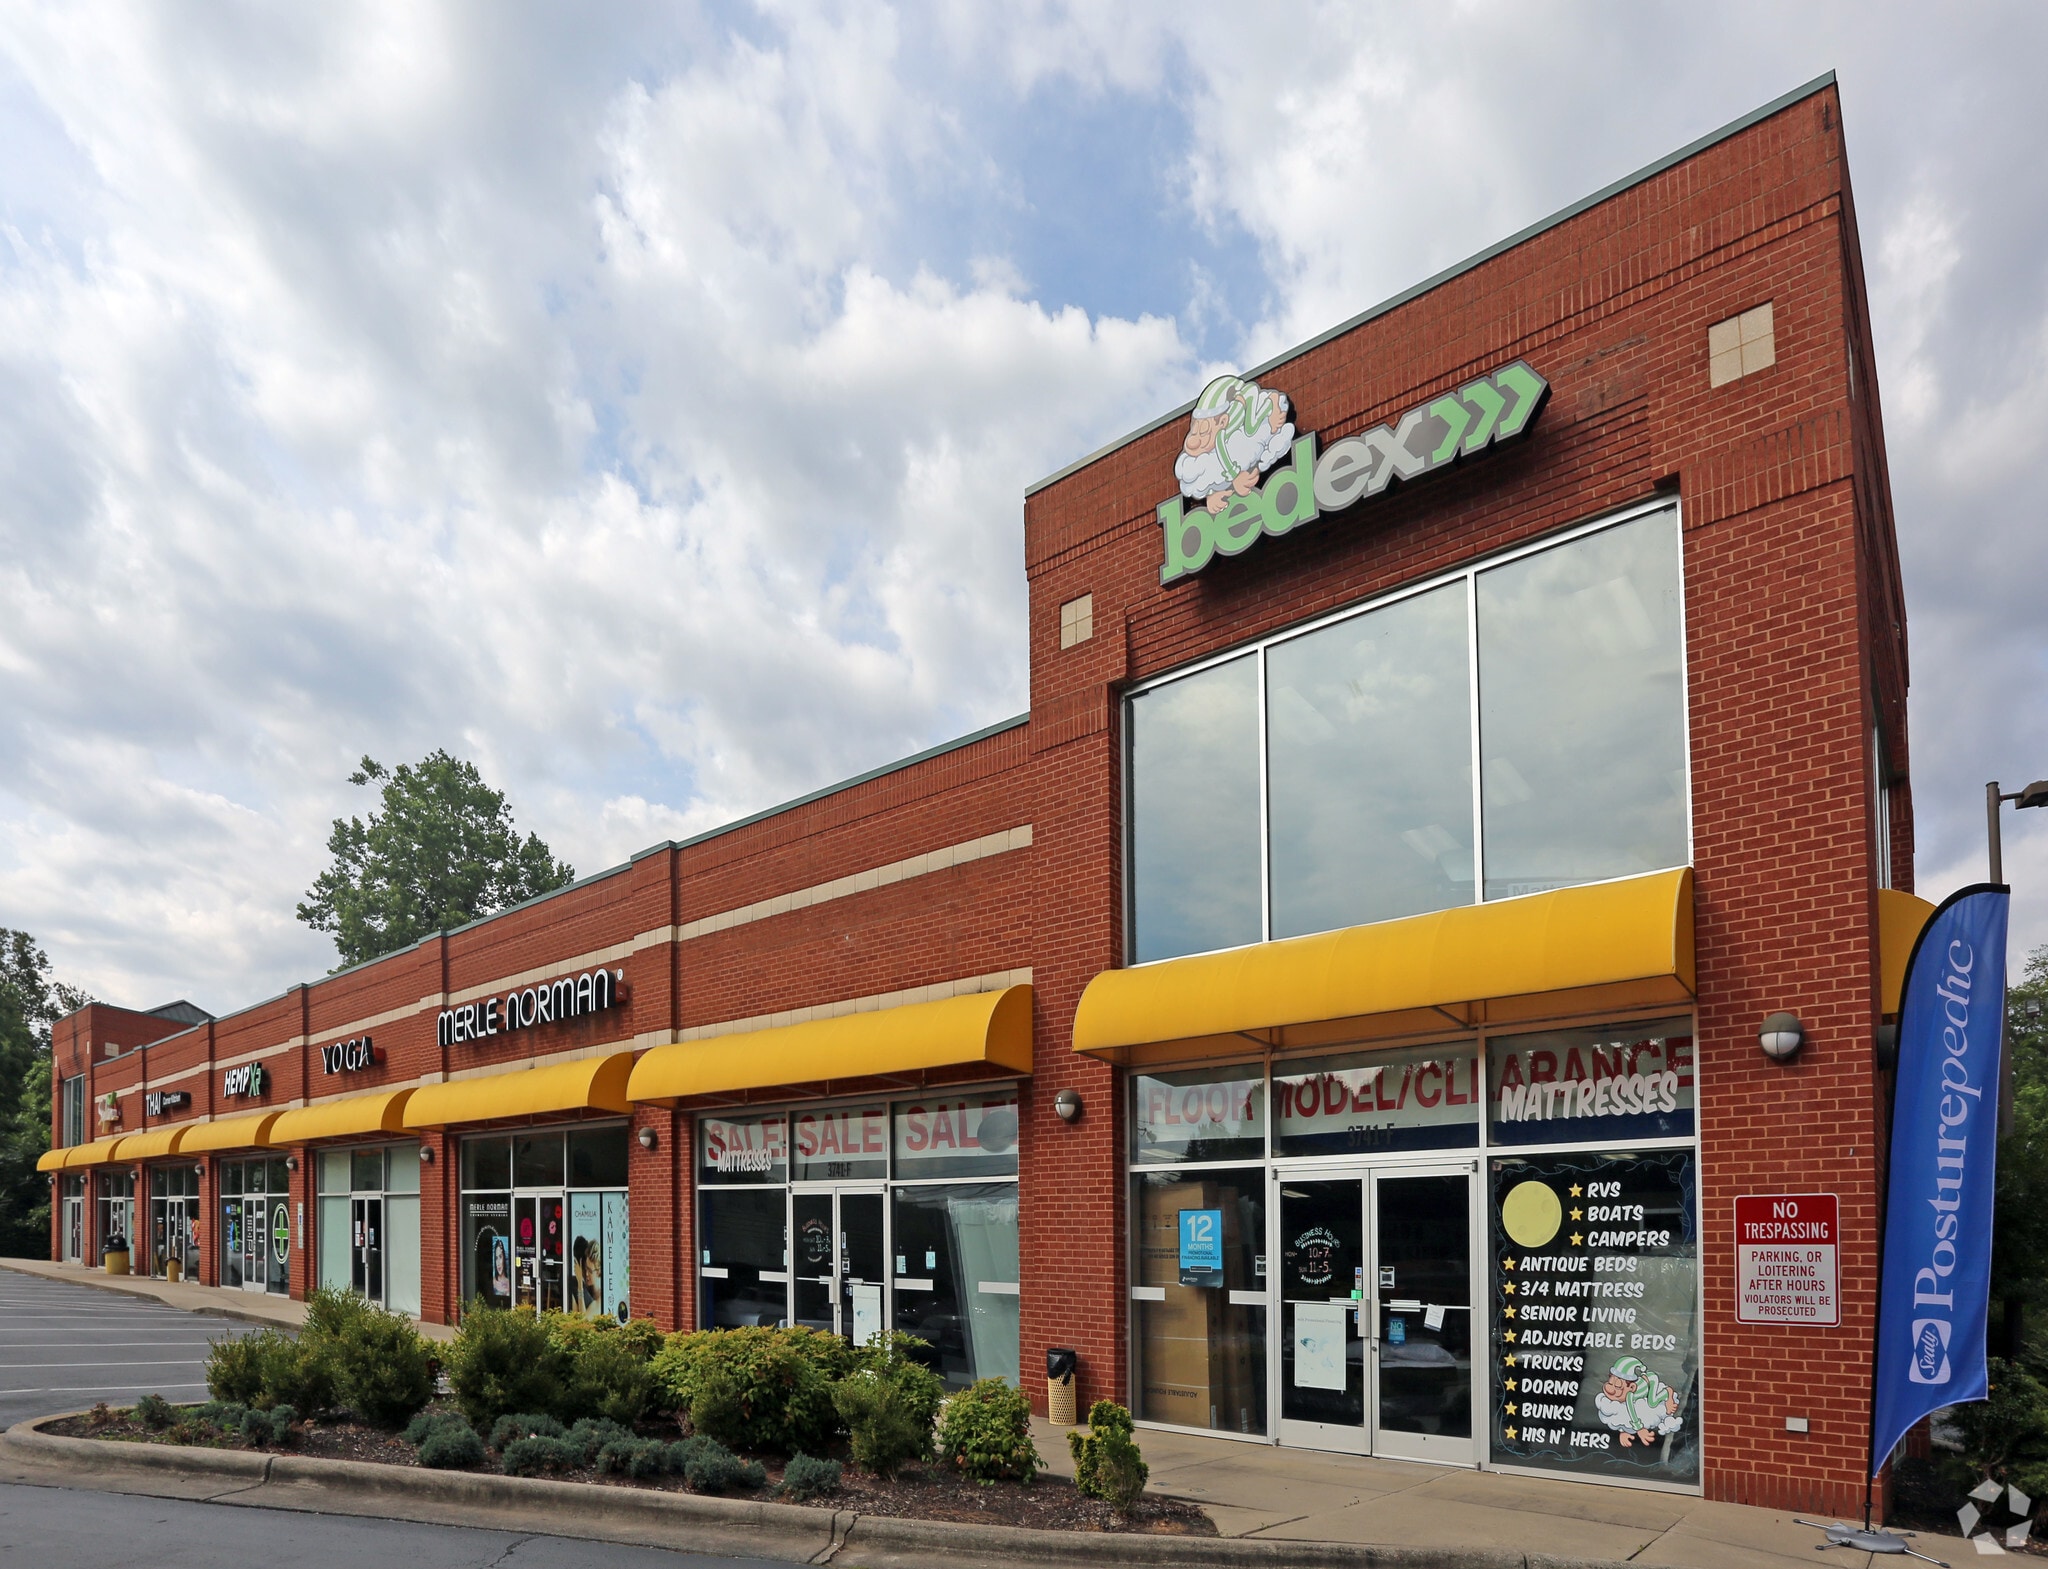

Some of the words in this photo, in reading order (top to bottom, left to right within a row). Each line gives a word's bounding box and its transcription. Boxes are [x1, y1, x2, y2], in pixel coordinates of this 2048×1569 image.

[1157, 411, 1428, 583] bedex
[437, 997, 498, 1047] MERLE
[506, 968, 608, 1031] NORMAN
[321, 1036, 370, 1075] YOGA
[145, 1091, 161, 1117] THAI
[1149, 1081, 1254, 1126] FLOOR
[1500, 1070, 1678, 1123] MATTRESSES
[1913, 939, 1982, 1312] Posturepedic
[717, 1149, 772, 1173] MATTRESSES
[1587, 1182, 1621, 1198] RVS
[1587, 1205, 1644, 1222] BOATS
[1773, 1201, 1798, 1219] NO
[1187, 1215, 1213, 1242] 12
[1294, 1227, 1323, 1248] BUSINESS
[1744, 1222, 1829, 1239] TRESPASSING
[1187, 1243, 1214, 1251] MONTHS
[1587, 1230, 1670, 1248] CAMPERS
[1519, 1256, 1589, 1273] ANTIQUE
[1593, 1256, 1637, 1273] BEDS
[1806, 1251, 1822, 1263] OR
[1758, 1265, 1815, 1277] LOITERING
[1520, 1281, 1549, 1297] 3/4
[1554, 1281, 1644, 1298] MATTRESS
[1749, 1279, 1783, 1291] AFTER
[1787, 1280, 1826, 1292] HOURS
[1744, 1294, 1792, 1305] VIOLATORS
[1794, 1295, 1816, 1306] WILL
[1818, 1296, 1831, 1306] BE
[1520, 1306, 1577, 1322] SENIOR
[1582, 1306, 1636, 1324] LIVING
[1758, 1306, 1816, 1317] PROSECUTED
[1520, 1330, 1625, 1349] ADJUSTABLE
[1630, 1333, 1676, 1351] BEDS
[1919, 1330, 1939, 1376] Sealy
[1521, 1354, 1584, 1372] TRUCKS
[1521, 1378, 1579, 1397] DORMS
[1521, 1402, 1574, 1422] BUNKS
[1522, 1427, 1546, 1444] HIS
[1570, 1431, 1611, 1450] HERS
